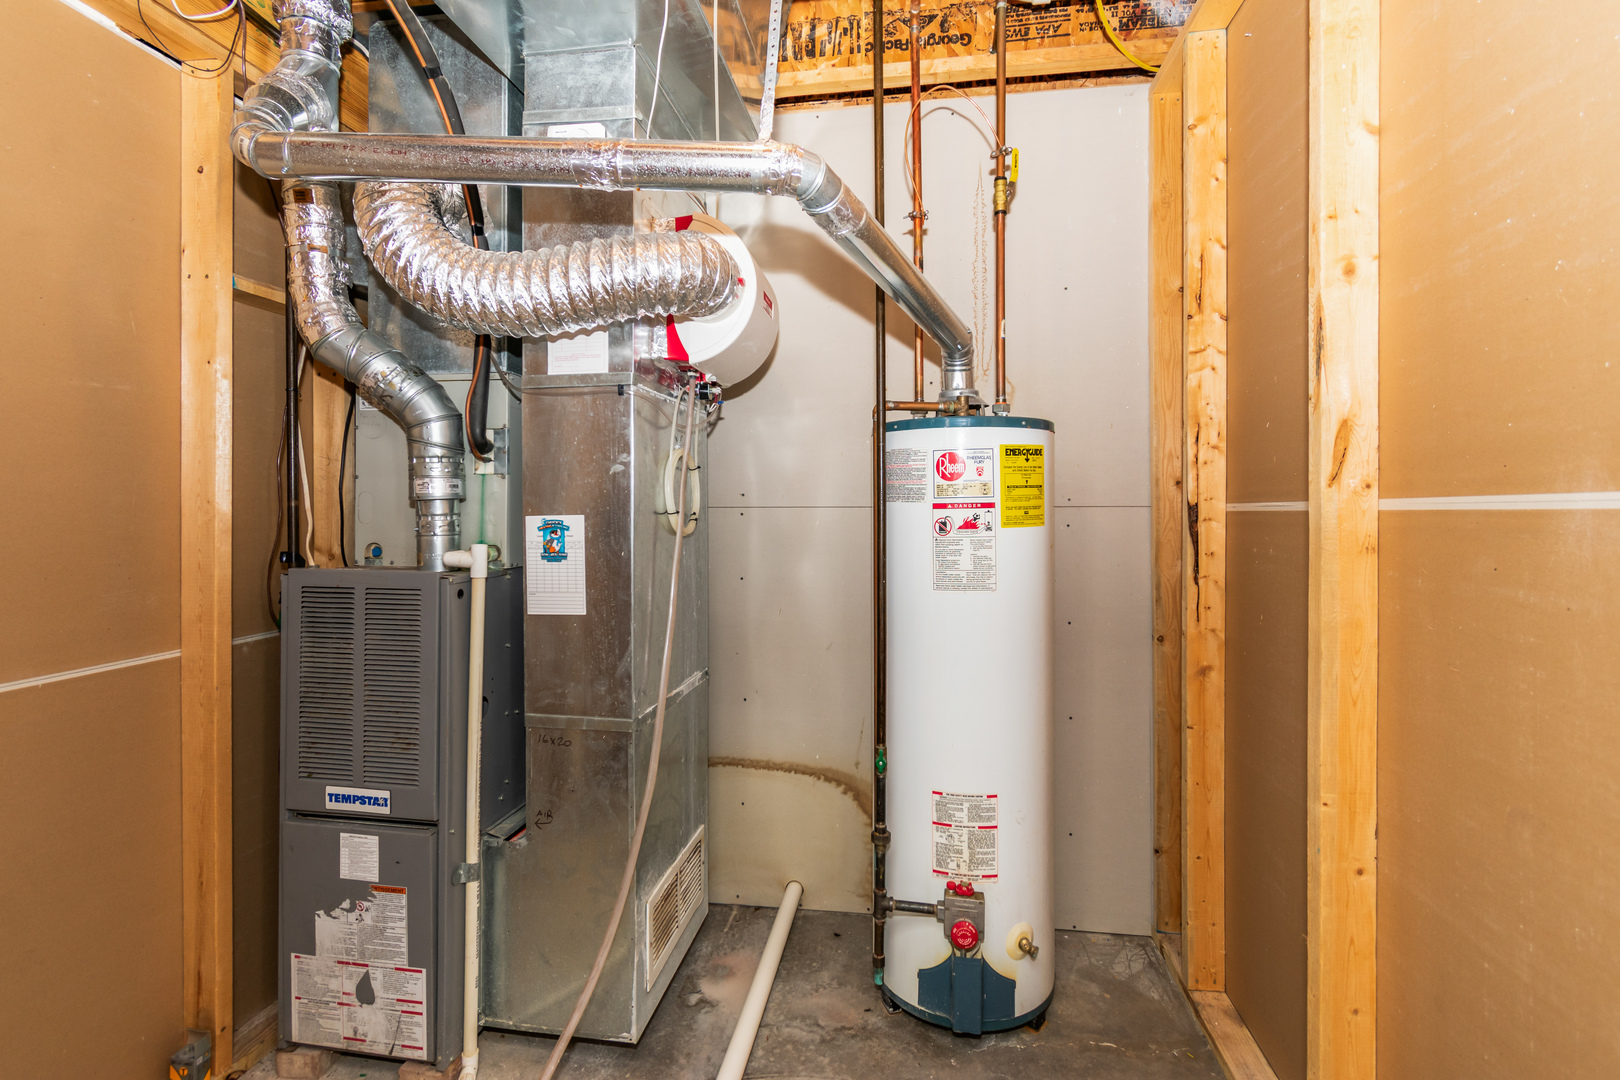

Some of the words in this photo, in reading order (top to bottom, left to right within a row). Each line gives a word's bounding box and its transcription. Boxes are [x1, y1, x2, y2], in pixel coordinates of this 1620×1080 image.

[1035, 23, 1062, 35] APA
[939, 453, 965, 477] Rheem
[327, 793, 389, 808] TEMPSTAR
[536, 809, 554, 820] AIR
